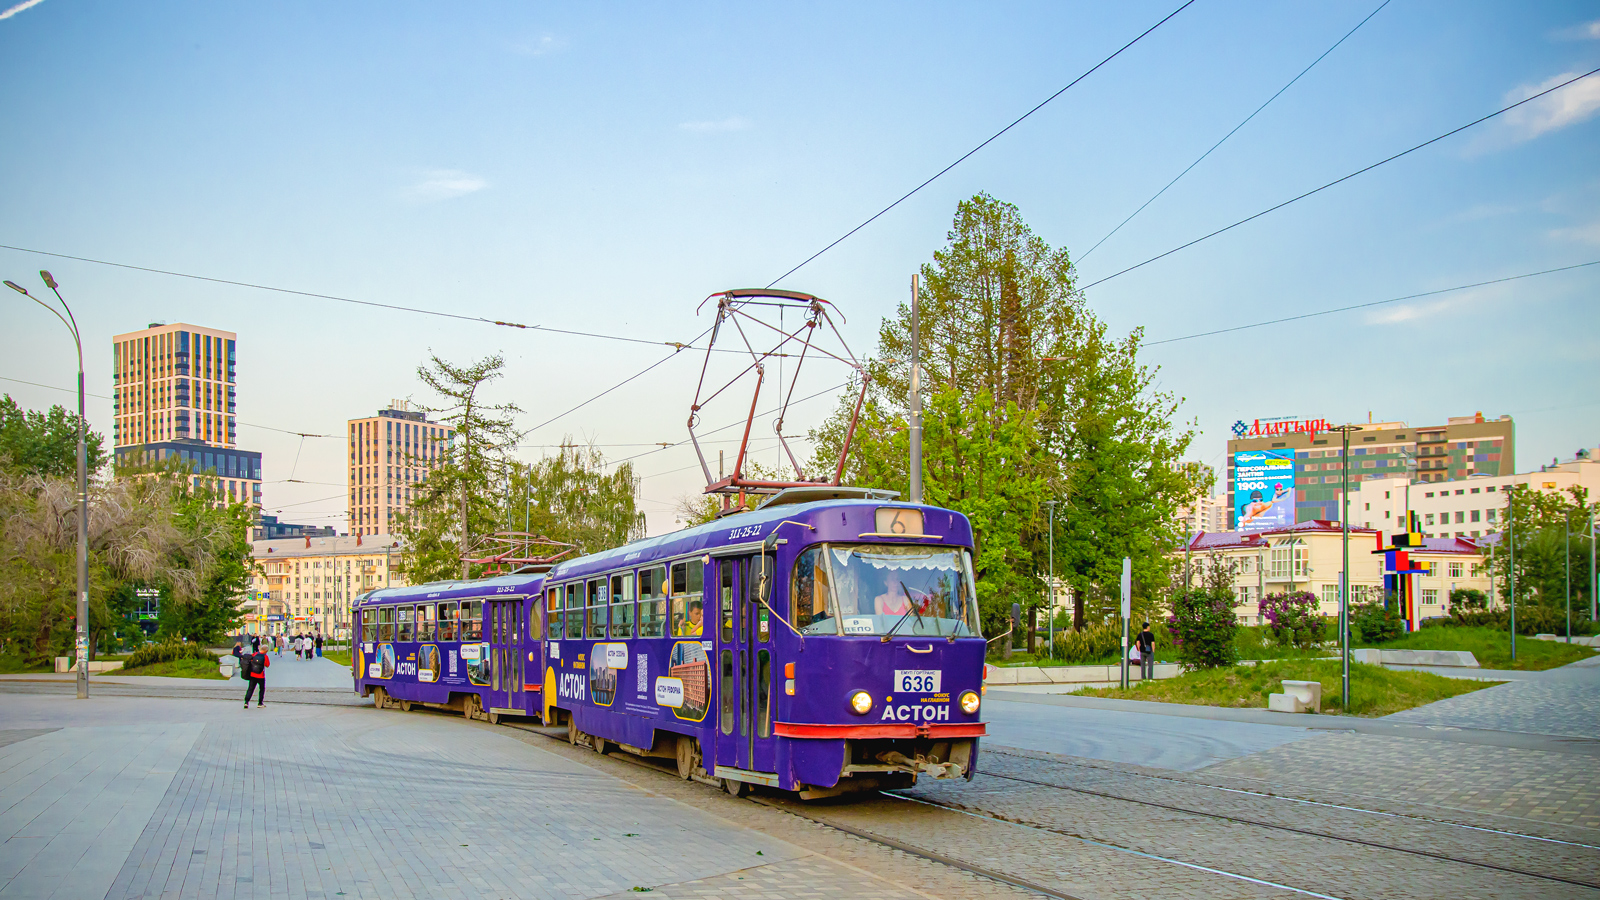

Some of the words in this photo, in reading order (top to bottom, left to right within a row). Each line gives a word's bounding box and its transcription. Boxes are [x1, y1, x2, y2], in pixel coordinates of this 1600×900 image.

[1248, 419, 1332, 443] Алатырь
[890, 511, 905, 533] 6
[728, 525, 762, 540] 311-25-22
[396, 662, 416, 675] АСТОН
[559, 673, 585, 701] АСТОН
[902, 676, 934, 692] 636
[881, 705, 949, 720] АСТОН
